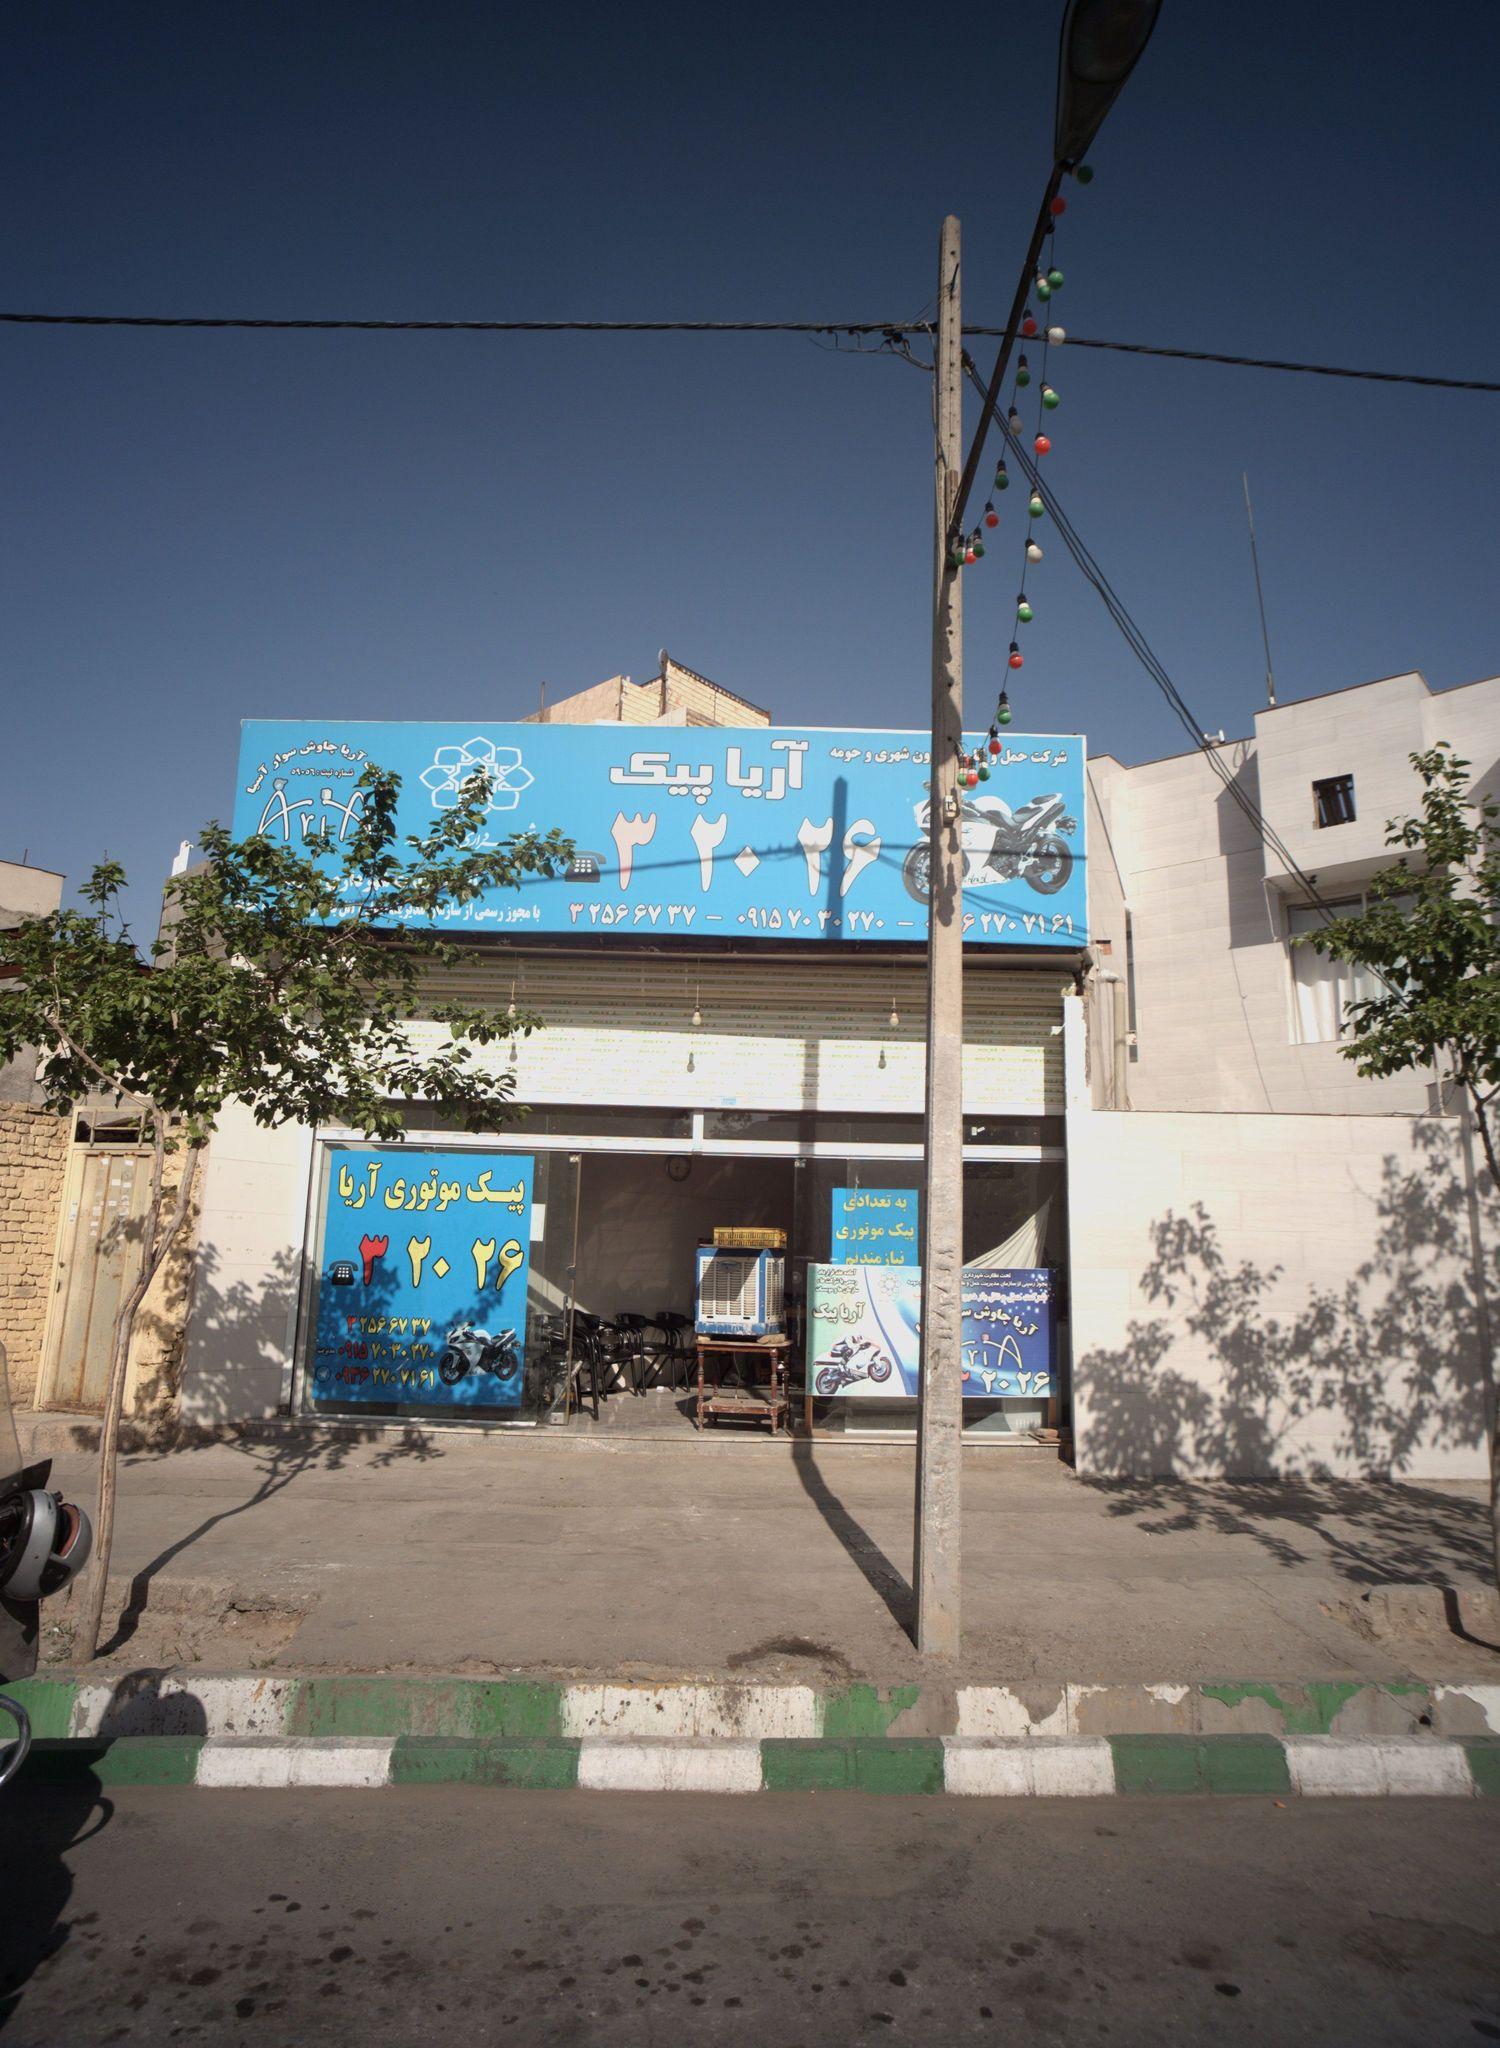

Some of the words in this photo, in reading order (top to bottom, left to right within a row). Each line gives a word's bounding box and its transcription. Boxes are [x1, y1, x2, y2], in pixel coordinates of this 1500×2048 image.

[299, 740, 338, 756] چاوش
[341, 744, 368, 761] آریا
[829, 747, 862, 763] حومه
[864, 750, 873, 763] و
[874, 746, 910, 764] شهری
[1000, 748, 1028, 765] حمل
[1030, 748, 1068, 768] شرکت
[608, 751, 714, 806] پیک
[725, 739, 810, 801] آریا
[610, 810, 657, 892] ۳
[689, 811, 762, 893] ۲۰
[797, 816, 883, 898] ۲۶
[463, 902, 474, 921] از
[474, 905, 504, 922] رسمی
[505, 904, 531, 923] مجوز
[533, 904, 541, 923] با
[338, 1161, 382, 1209] آریا
[384, 1168, 462, 1211] موتوری
[465, 1169, 525, 1216] پیک
[843, 1194, 892, 1212] تعدادی
[895, 1196, 907, 1212] به
[835, 1222, 884, 1241] موتوری
[888, 1222, 915, 1241] پیک
[359, 1233, 390, 1287] ۳
[407, 1235, 451, 1289] ۲۰
[471, 1237, 525, 1292] ۲۶
[812, 1303, 838, 1324] پیک
[839, 1301, 865, 1324] آریا
[973, 1305, 1012, 1326] چاوش
[1013, 1315, 1039, 1336] آریا
[1016, 1371, 1050, 1394] ۲۶
